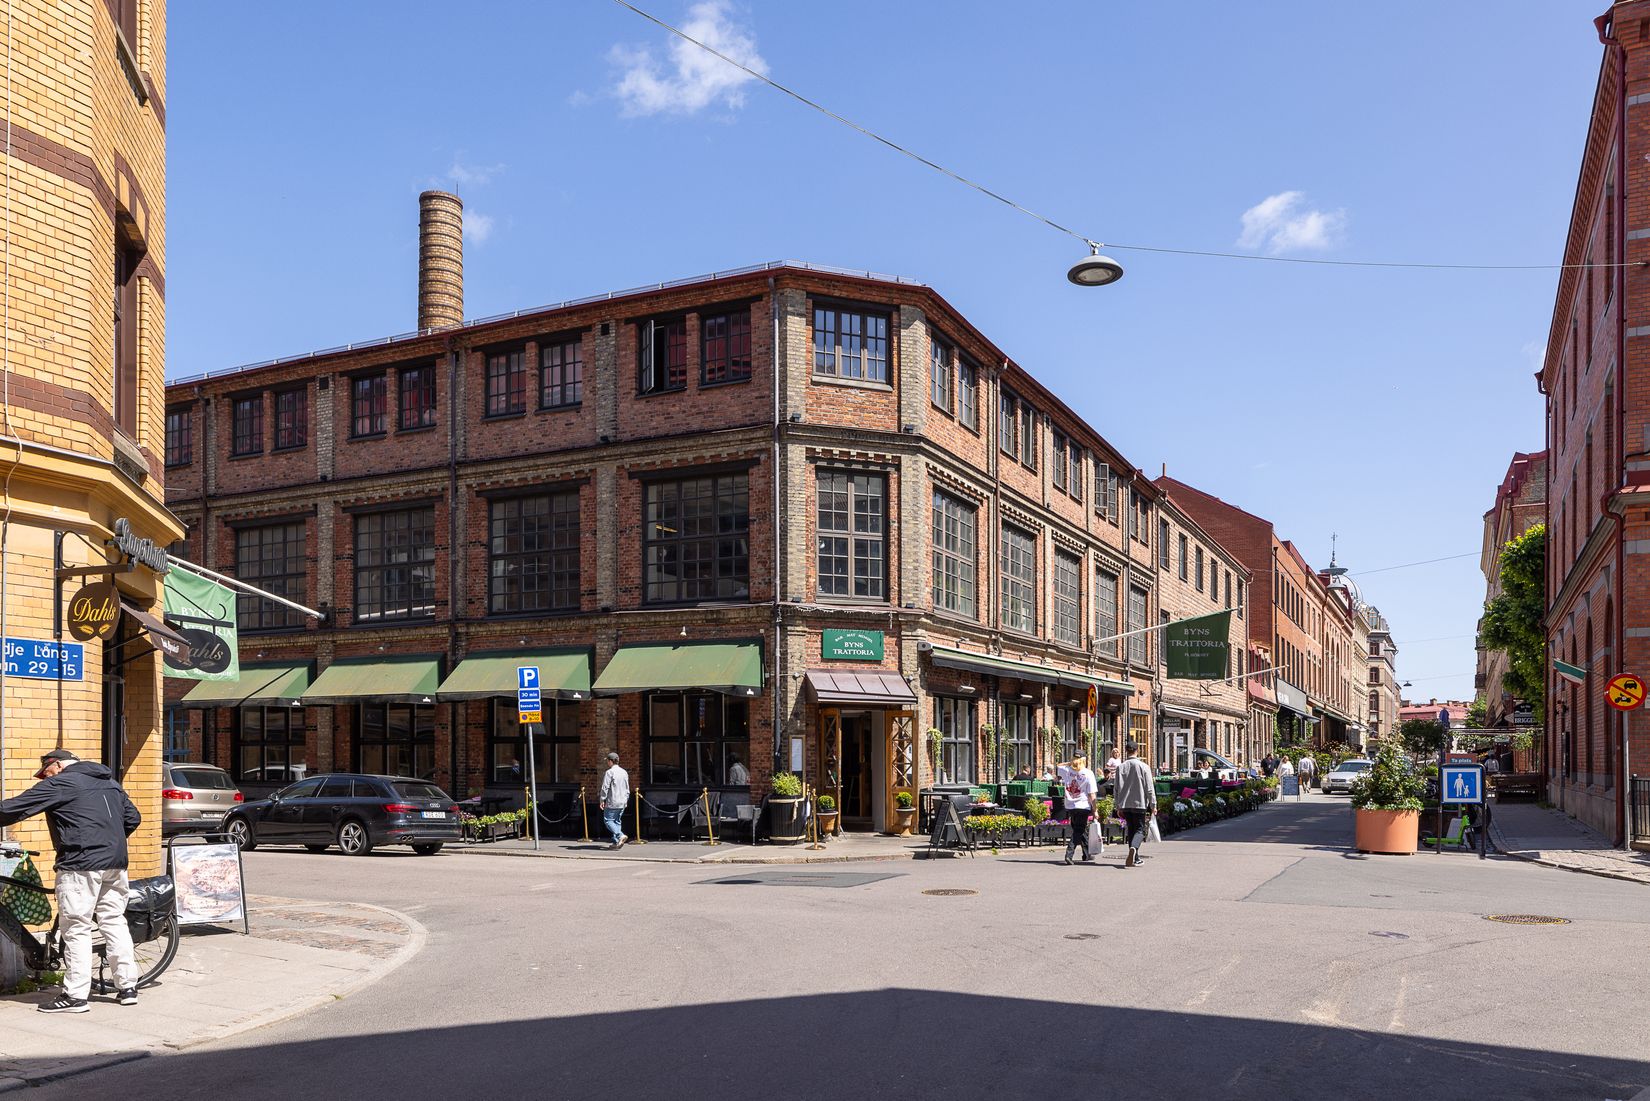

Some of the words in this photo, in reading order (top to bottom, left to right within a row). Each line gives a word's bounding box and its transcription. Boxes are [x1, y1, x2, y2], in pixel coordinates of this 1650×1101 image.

[73, 597, 116, 622] Dahls
[1184, 628, 1210, 636] BYNS
[1170, 639, 1225, 648] TRATTORIA
[523, 669, 536, 687] P
